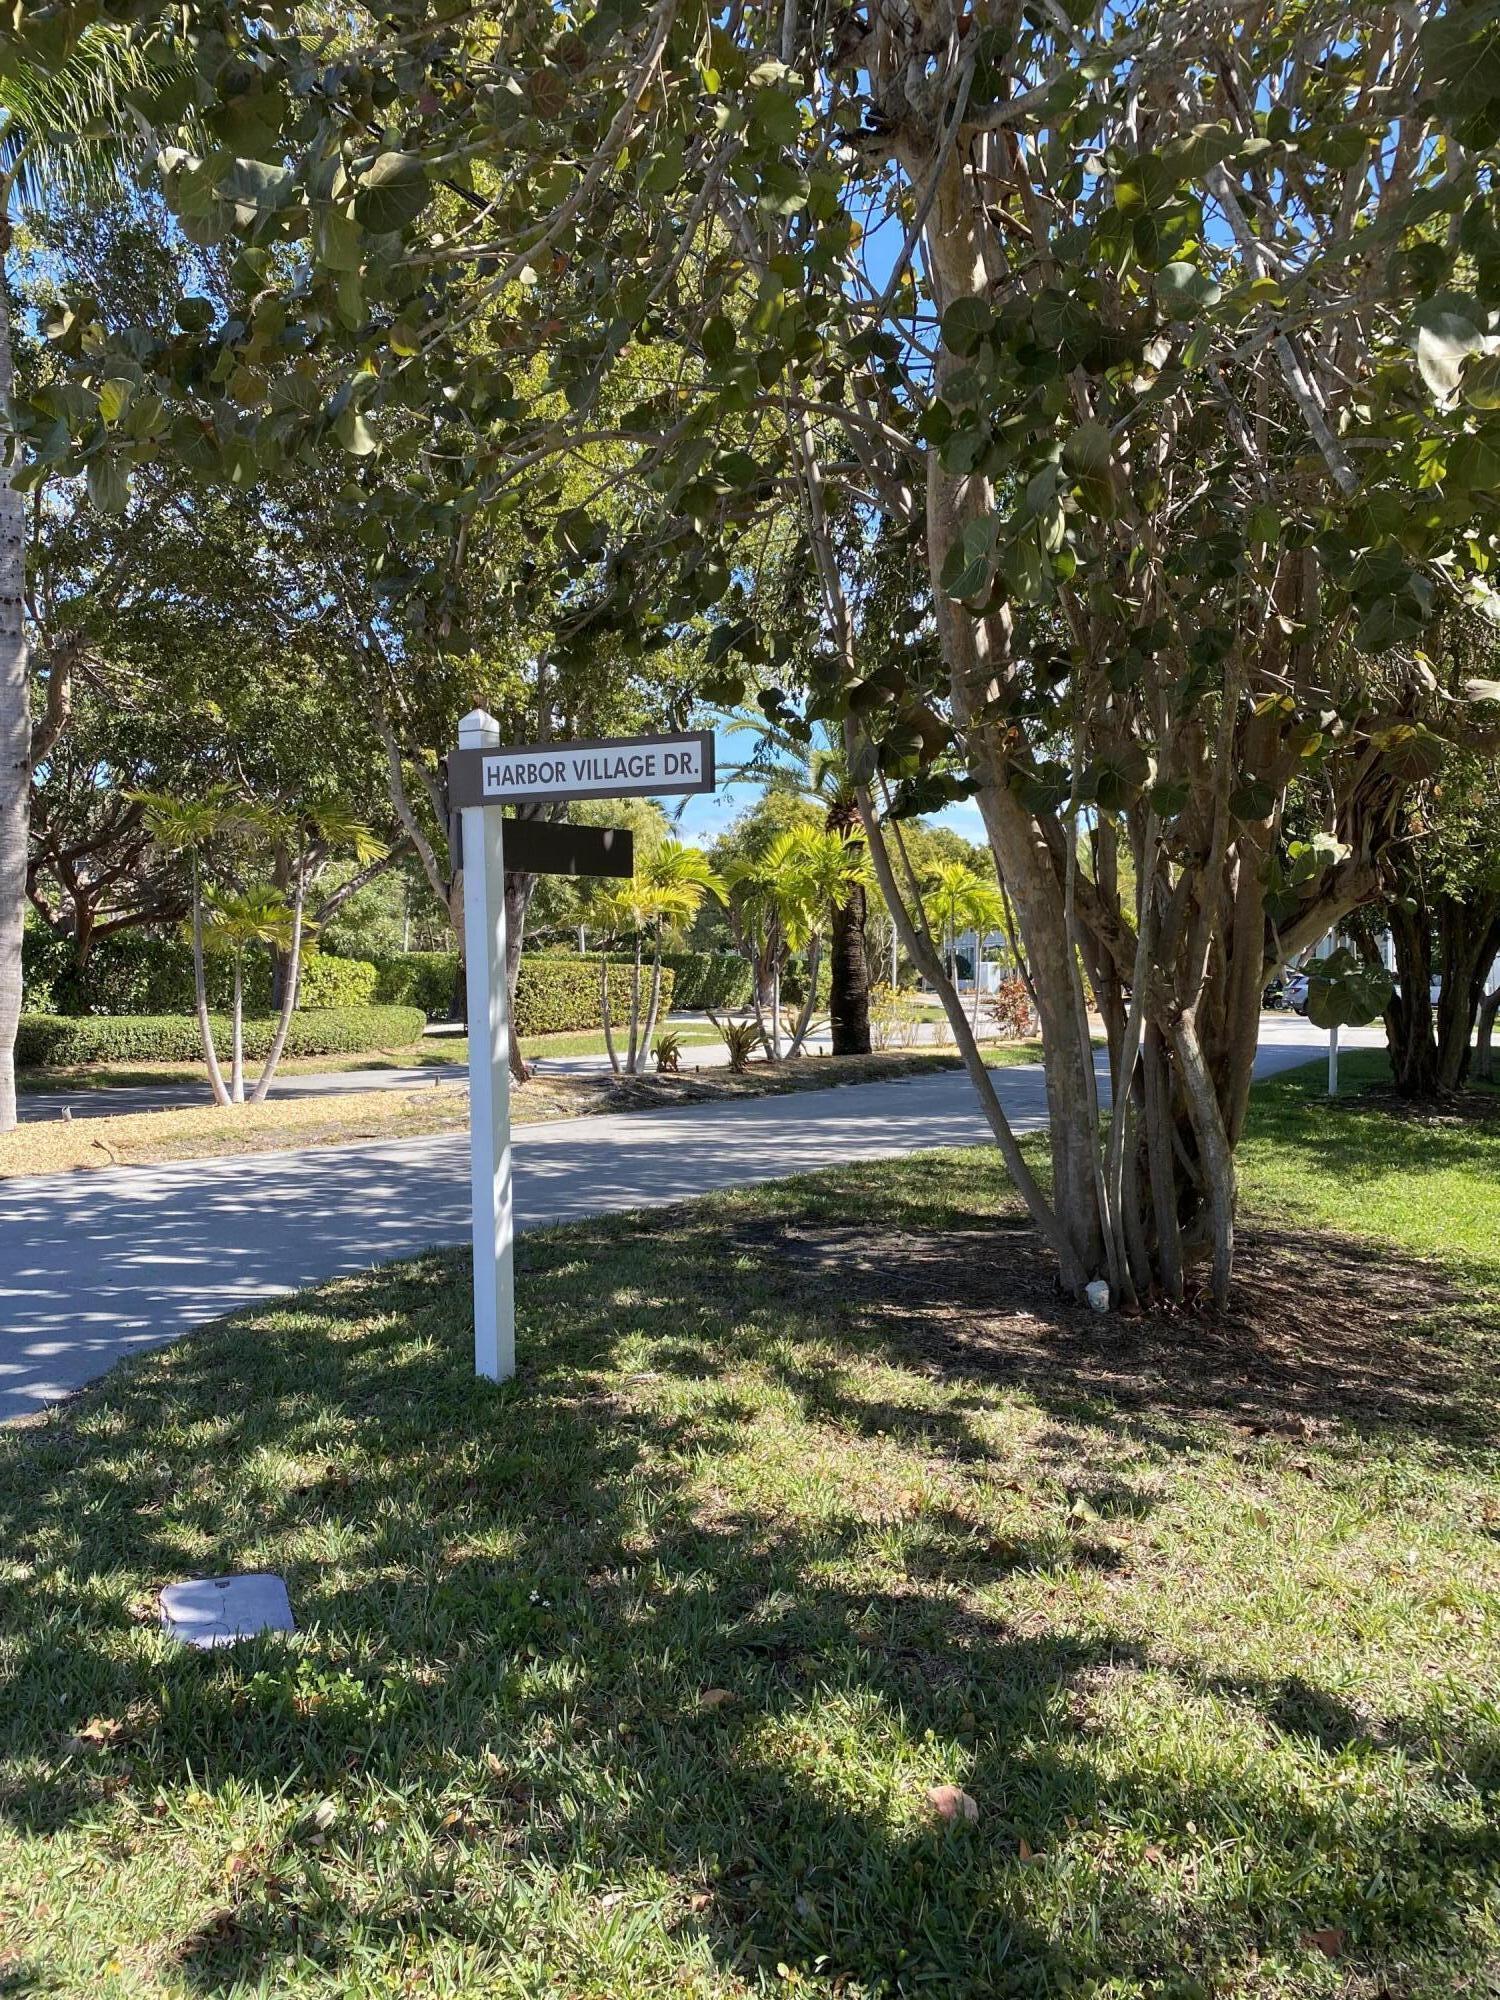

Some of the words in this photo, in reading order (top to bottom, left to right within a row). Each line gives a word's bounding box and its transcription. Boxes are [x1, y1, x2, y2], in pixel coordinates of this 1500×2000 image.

[487, 761, 566, 787] HARBOR
[573, 754, 656, 781] VILLAGE
[664, 752, 699, 776] DR.
